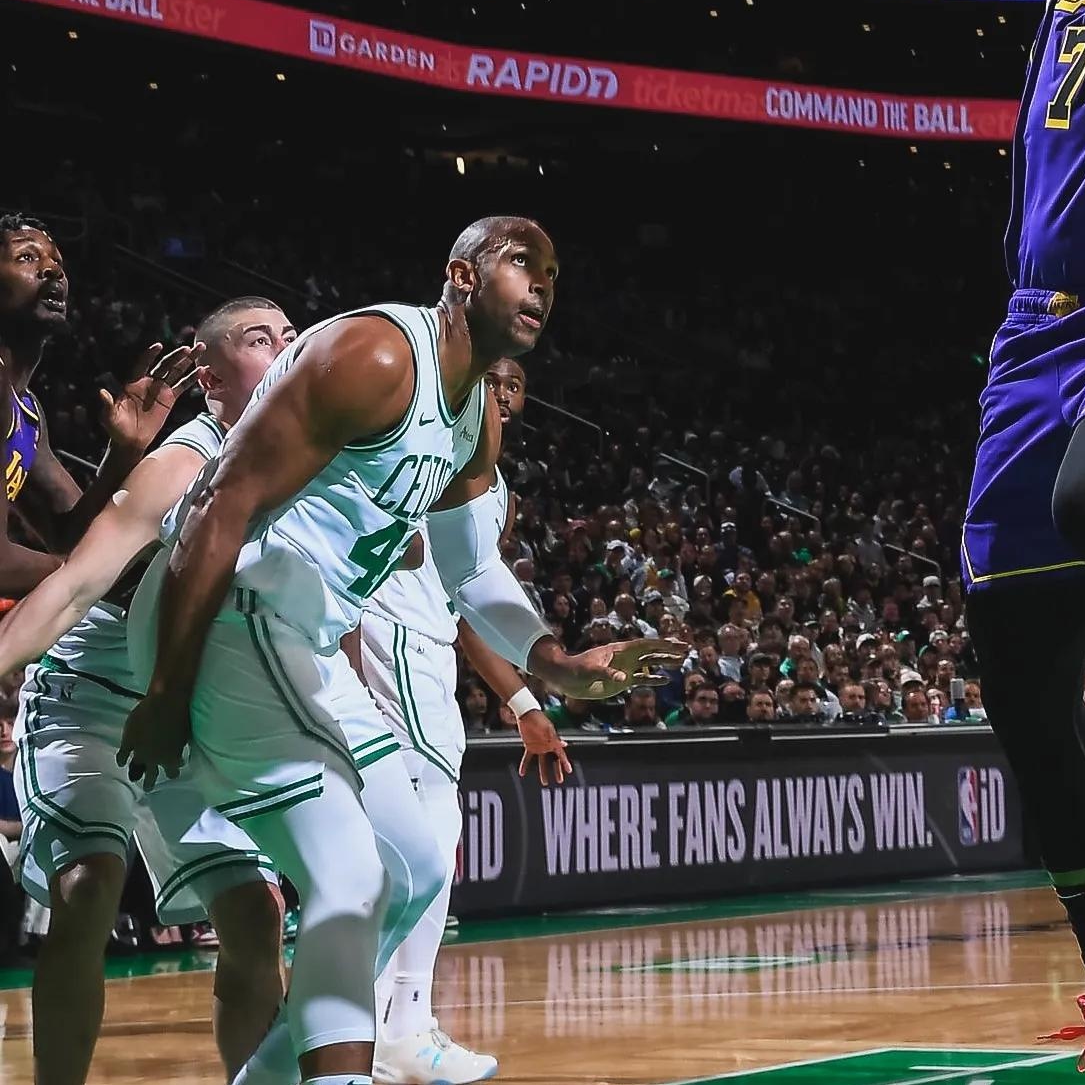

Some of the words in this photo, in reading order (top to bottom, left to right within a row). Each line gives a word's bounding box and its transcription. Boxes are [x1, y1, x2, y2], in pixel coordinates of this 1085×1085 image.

[339, 31, 435, 72] GARDEN
[765, 86, 878, 128] COMMAND
[882, 98, 909, 132] THE
[914, 103, 974, 134] BALL
[347, 519, 414, 599] 4
[541, 783, 661, 876] WHERE
[668, 778, 747, 867] FANS
[752, 773, 866, 860] ALWAYS
[868, 771, 934, 851] WIN.
